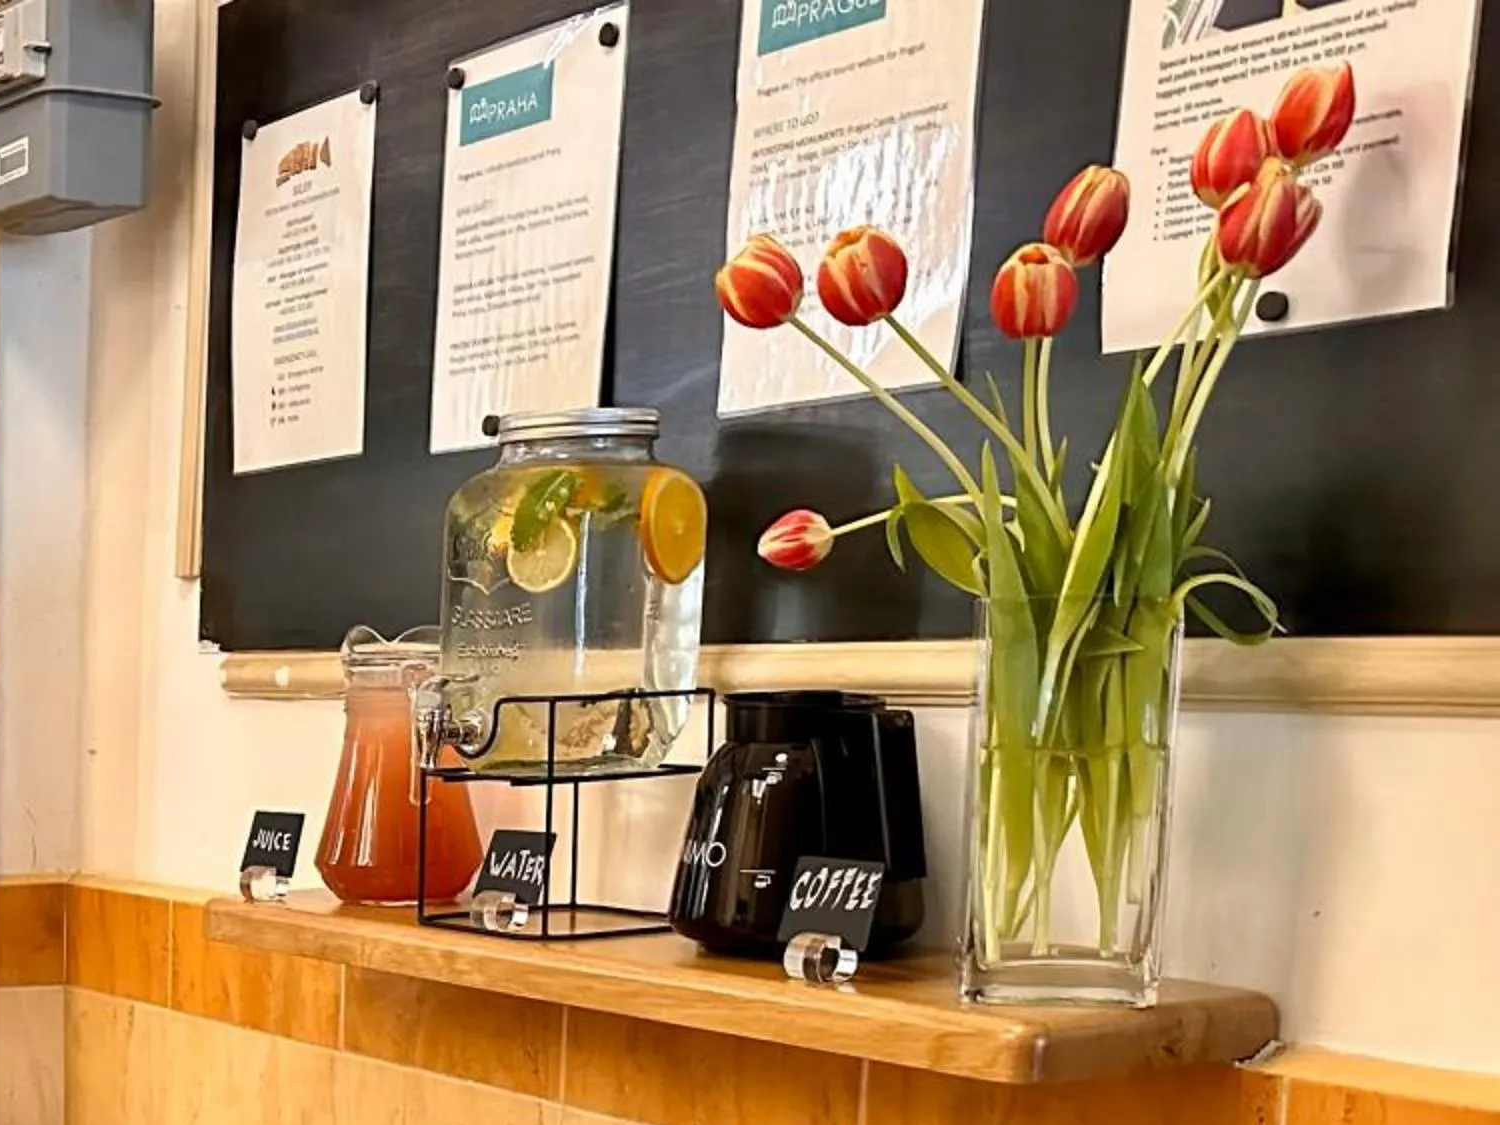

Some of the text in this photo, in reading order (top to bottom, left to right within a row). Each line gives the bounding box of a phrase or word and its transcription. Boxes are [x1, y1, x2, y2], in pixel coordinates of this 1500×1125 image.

[488, 92, 539, 125] PRAHA
[252, 827, 293, 852] JUICE
[489, 849, 545, 886] WATER
[789, 867, 883, 911] COFFEE
